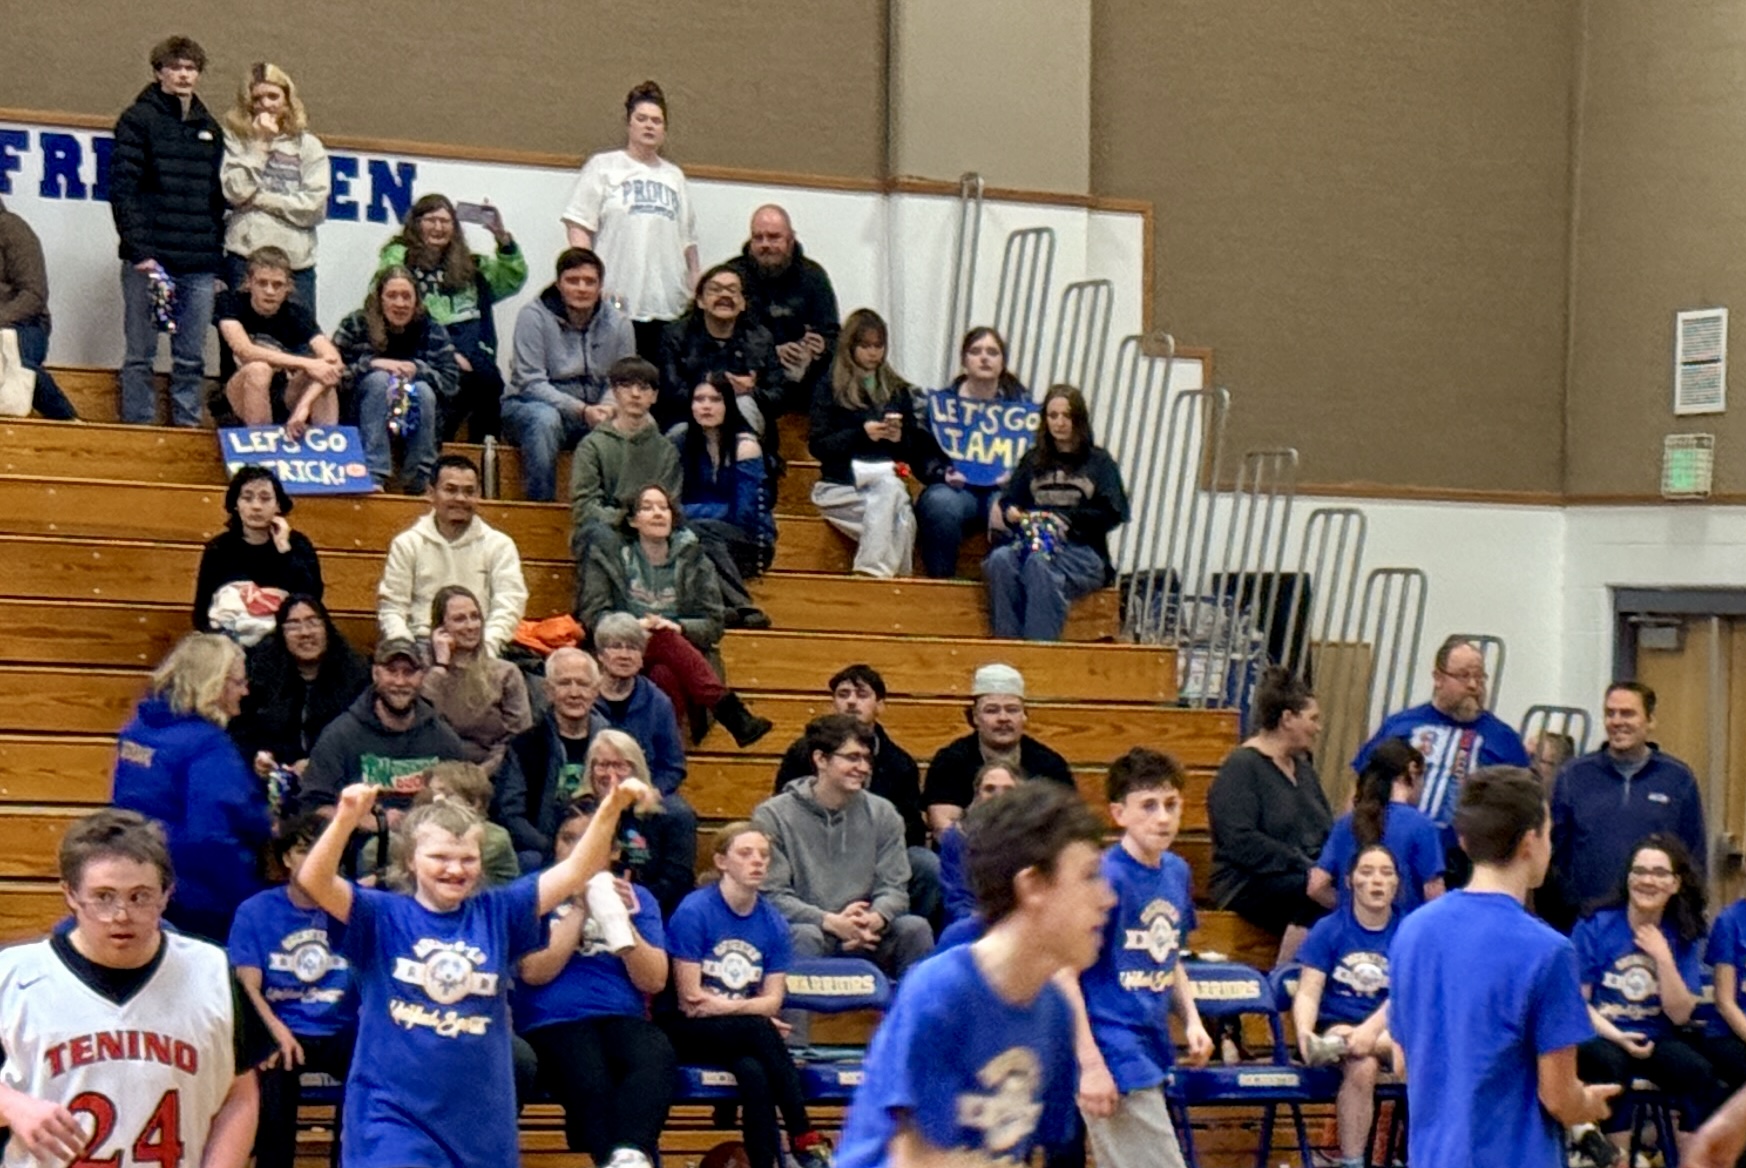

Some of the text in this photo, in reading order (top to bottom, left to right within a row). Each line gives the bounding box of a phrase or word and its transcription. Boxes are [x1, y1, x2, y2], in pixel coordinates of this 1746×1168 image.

[931, 395, 1041, 435] LET'S GO
[304, 428, 348, 452] GO
[44, 1030, 198, 1079] TENINO
